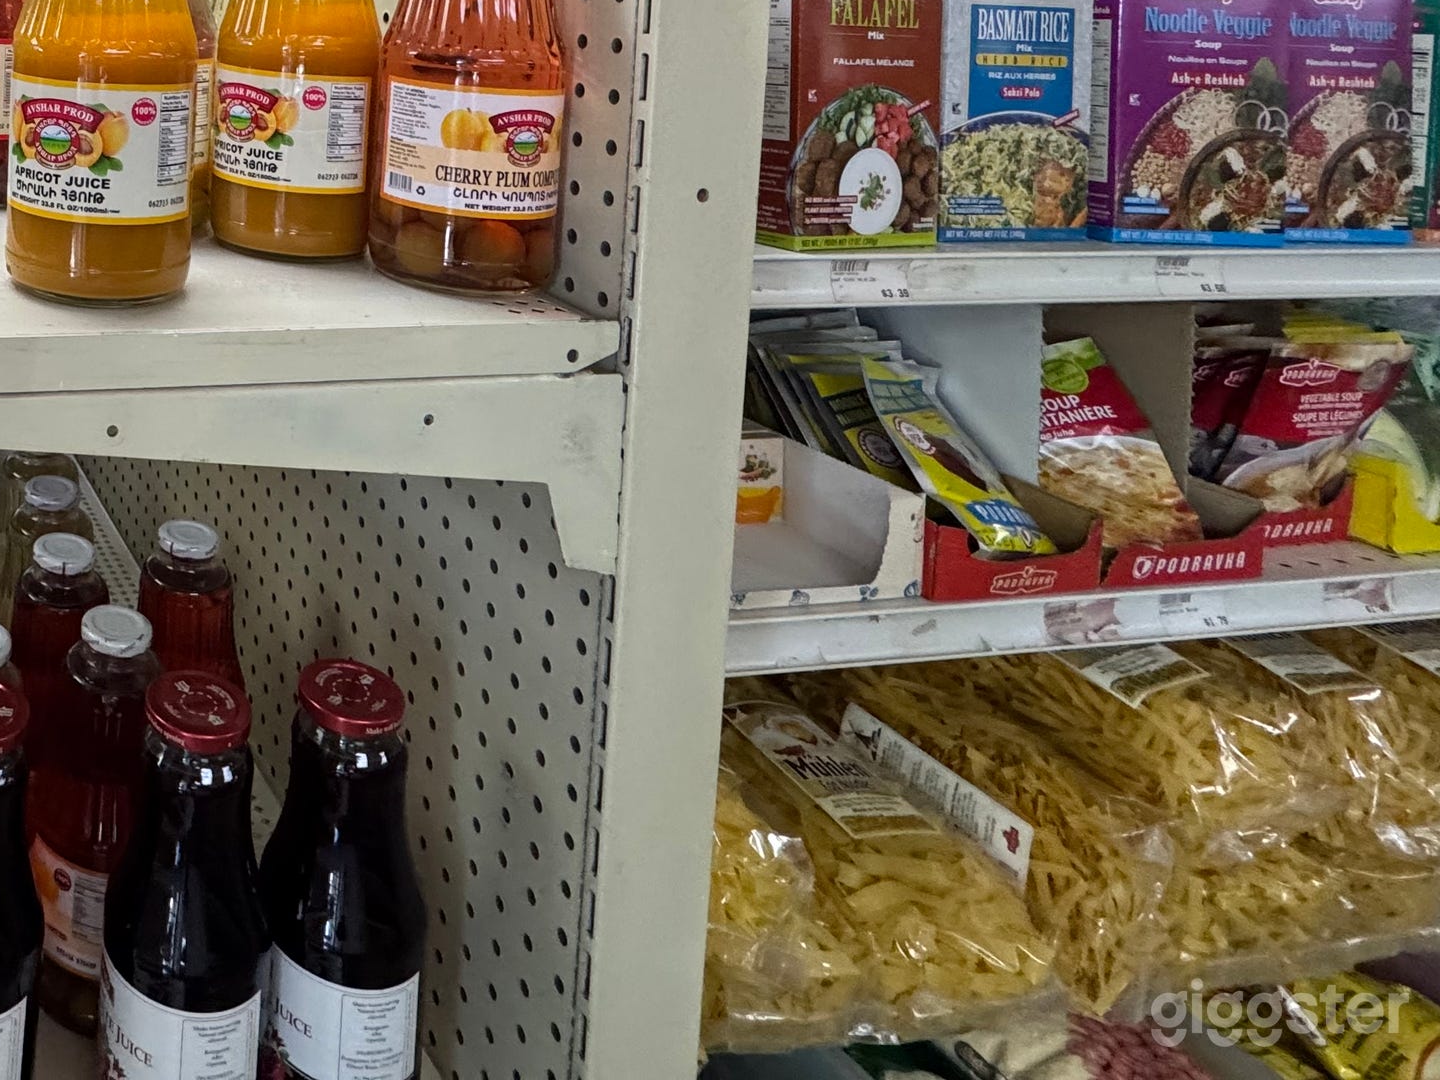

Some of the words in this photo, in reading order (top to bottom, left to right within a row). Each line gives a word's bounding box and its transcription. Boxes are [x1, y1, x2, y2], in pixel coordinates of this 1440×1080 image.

[977, 8, 1037, 41] BASMATI
[1039, 11, 1070, 43] RICE
[1145, 6, 1208, 34] Noodle
[1213, 10, 1273, 40] Veggie
[1289, 12, 1342, 37] Noodle
[1345, 14, 1398, 44] Veggie
[868, 31, 884, 40] Mix
[1016, 44, 1033, 53] Mix
[1194, 40, 1222, 51] Soup
[1329, 44, 1355, 54] Soup
[833, 57, 876, 67] FALLAFEL
[1003, 72, 1022, 80] AUX
[1171, 72, 1201, 85] Ash-e
[1204, 73, 1245, 86] Reshteh
[1310, 75, 1336, 88] Ash-e
[1338, 76, 1375, 89] Reshteh
[245, 88, 270, 106] PROD
[305, 94, 326, 102] 100%
[26, 103, 61, 116] AVSHAR
[64, 105, 95, 123] PROD
[134, 106, 156, 115] 100%
[497, 113, 532, 126] AVSHAR
[533, 114, 552, 126] PROD
[246, 147, 284, 161] JUICE
[15, 165, 62, 185] APRICOT
[65, 176, 111, 190] JUICE
[435, 164, 491, 186] CHERRY
[495, 170, 530, 188] PLUM
[533, 170, 558, 187] COMP
[20, 193, 40, 206] WEIGHT
[464, 202, 480, 210] NET
[482, 204, 511, 212] WEIGHT
[1301, 392, 1340, 403] VEGETABLE
[1341, 391, 1363, 402] SOUP
[1292, 412, 1318, 422] SOUPE
[1318, 411, 1329, 421] DE
[1155, 551, 1246, 575] PODRAVKA
[995, 575, 1051, 589] PODRAVKA
[273, 1000, 313, 1039] JUICE
[115, 1031, 154, 1069] JUICE
